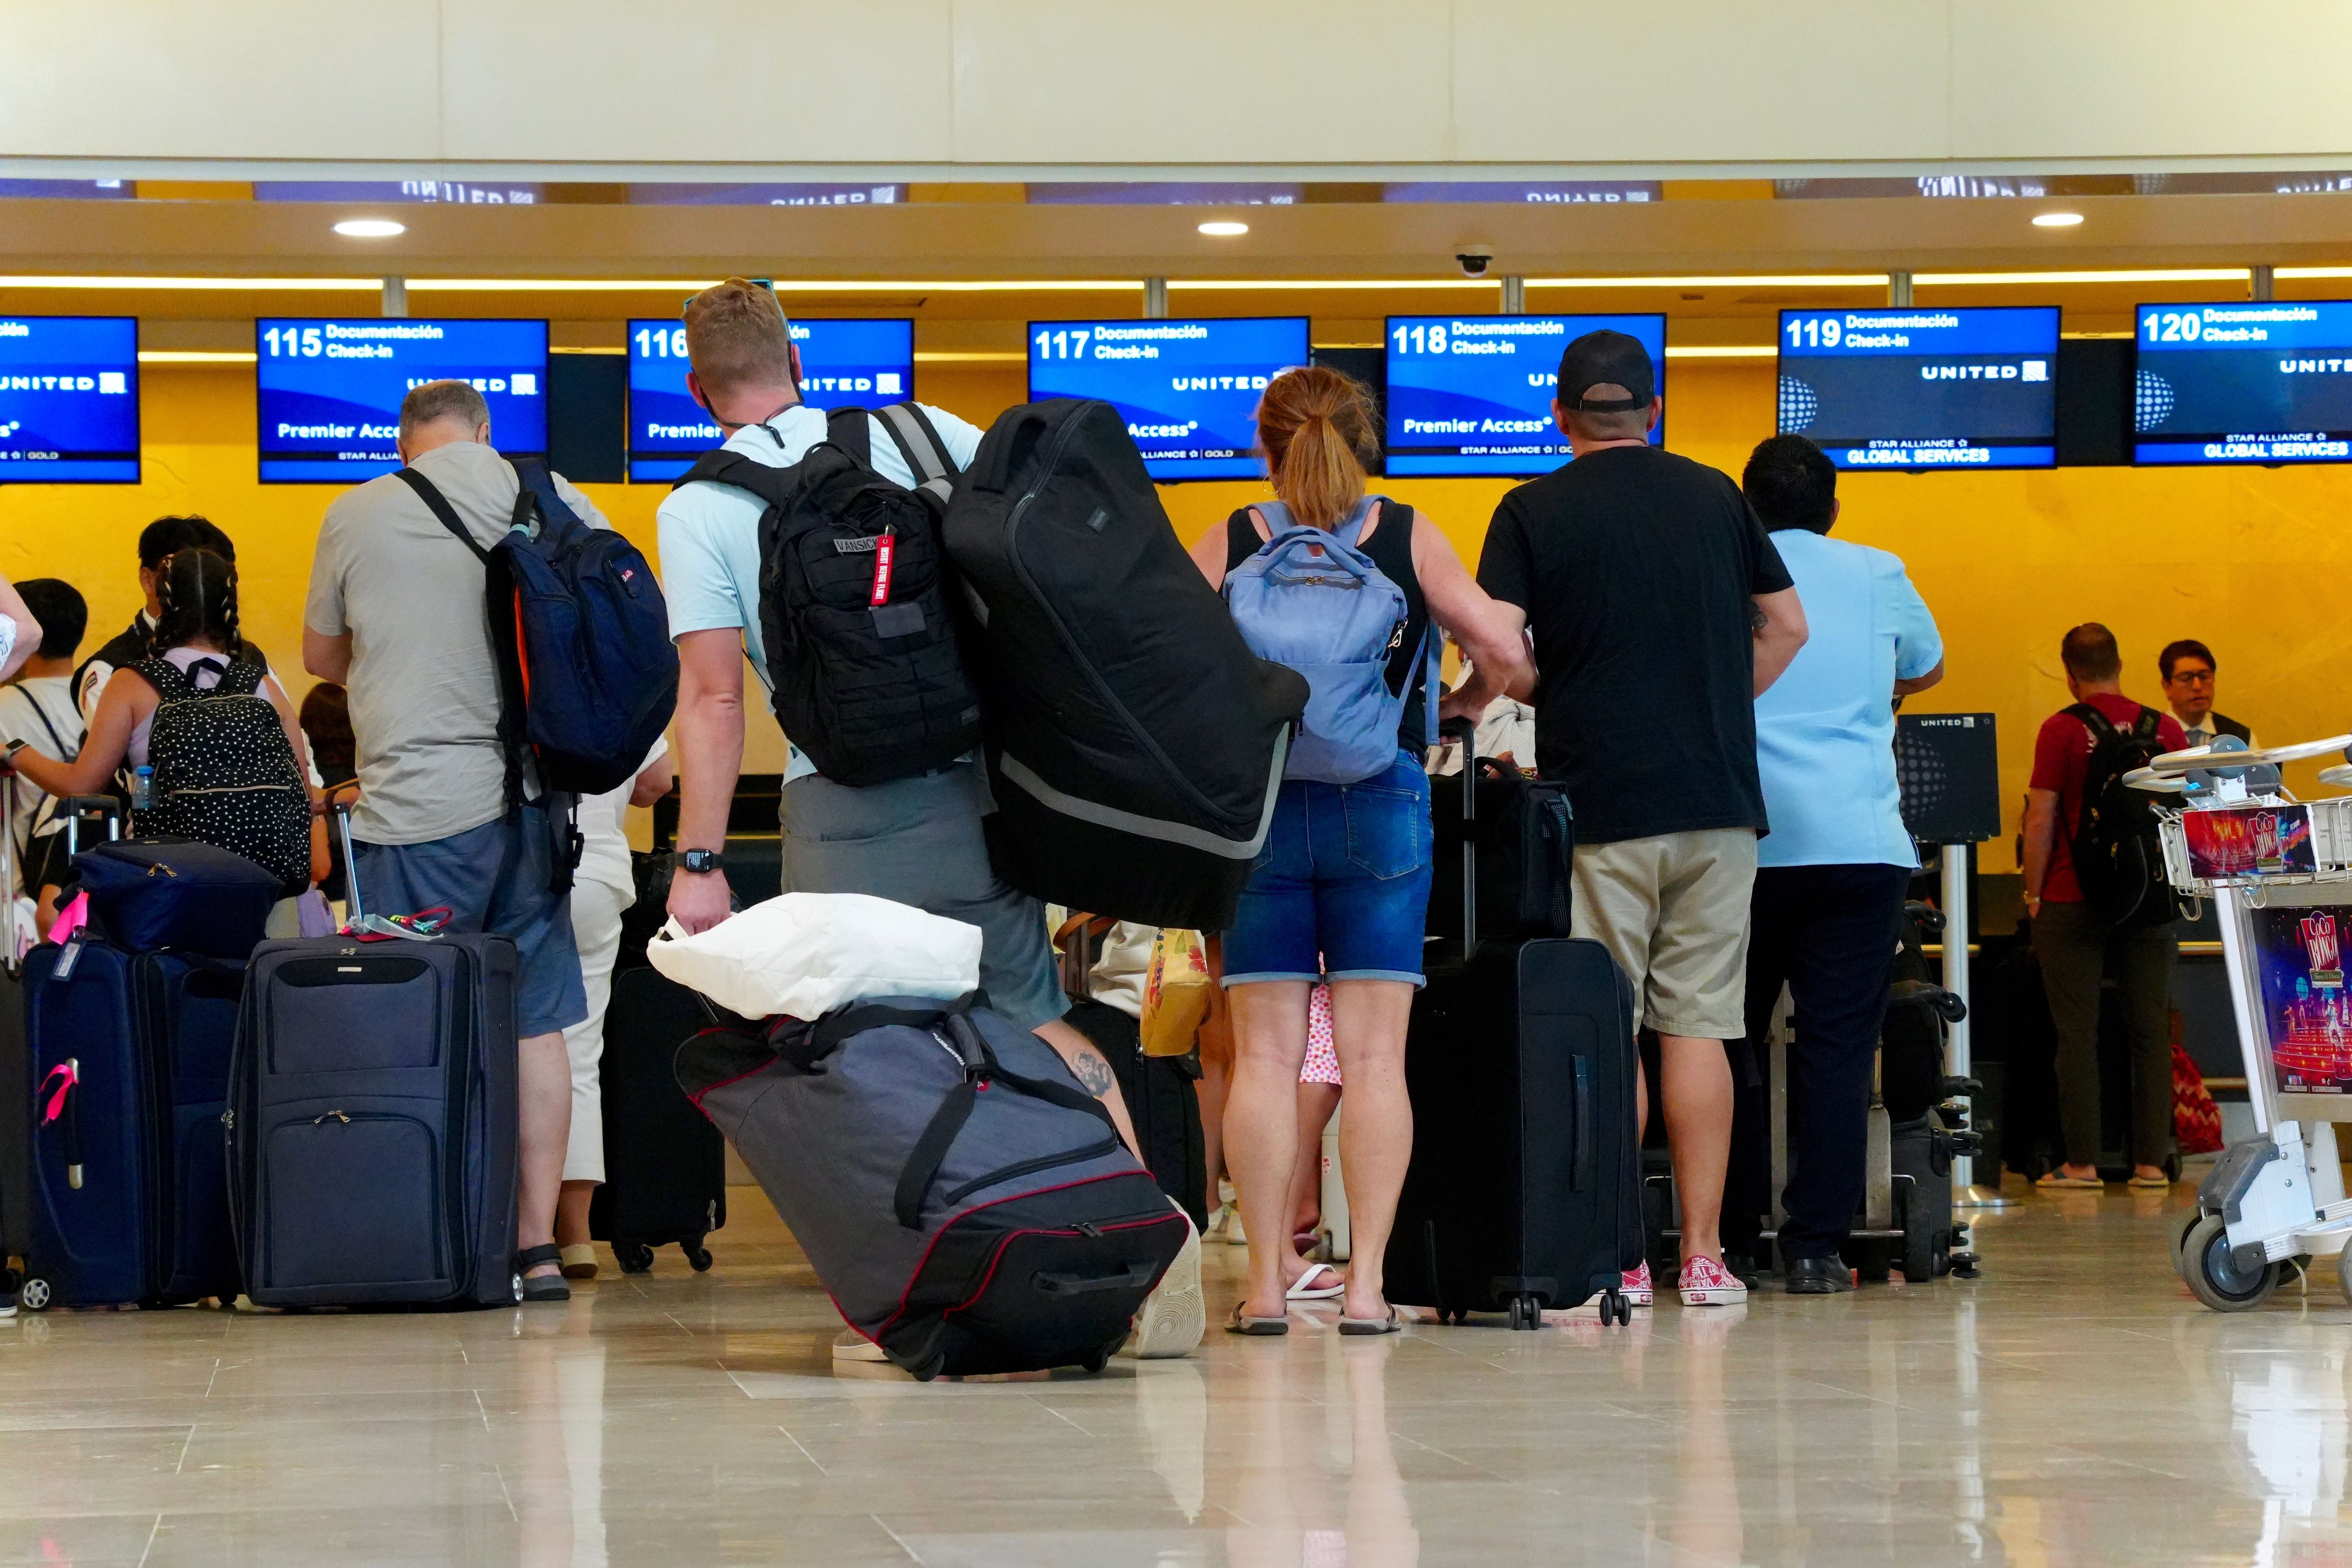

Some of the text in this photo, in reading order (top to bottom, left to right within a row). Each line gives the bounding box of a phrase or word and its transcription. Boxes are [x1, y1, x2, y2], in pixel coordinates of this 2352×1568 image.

[1846, 314, 1958, 329] Documentación
[2203, 308, 2317, 322] Documentación
[326, 324, 443, 339] Documentación
[1095, 325, 1208, 340] Documentación
[1452, 321, 1564, 335] Documentación
[1787, 319, 1841, 347] 119
[2144, 313, 2200, 341] 120
[2203, 327, 2268, 341] Check-in
[264, 328, 322, 357] 115
[635, 329, 688, 357] 116
[1035, 331, 1090, 359] 117
[1393, 326, 1447, 354] 118
[1451, 340, 1515, 354] Check-in
[1845, 334, 1909, 348] Check-in
[326, 344, 393, 358] Check-in
[1094, 345, 1159, 359] Check-in
[1922, 366, 2017, 379] UNITED
[2280, 359, 2352, 373] UNITE
[407, 379, 506, 392] UED
[799, 379, 871, 391] NITED
[1173, 377, 1267, 391] UNITED
[278, 424, 400, 438] Premier Acce
[649, 424, 722, 438] Premier
[1404, 419, 1478, 433] Premier
[1869, 439, 1955, 449] STAR ALLIANCE
[2226, 433, 2313, 443] STAR ALLIANCE
[28, 451, 58, 460] GOLD
[1848, 448, 1990, 464] GLOBAL SERVICES
[2204, 442, 2349, 458] GLOBAL SERVICES
[875, 547, 889, 599] INSERT BEFORE FLIGHT
